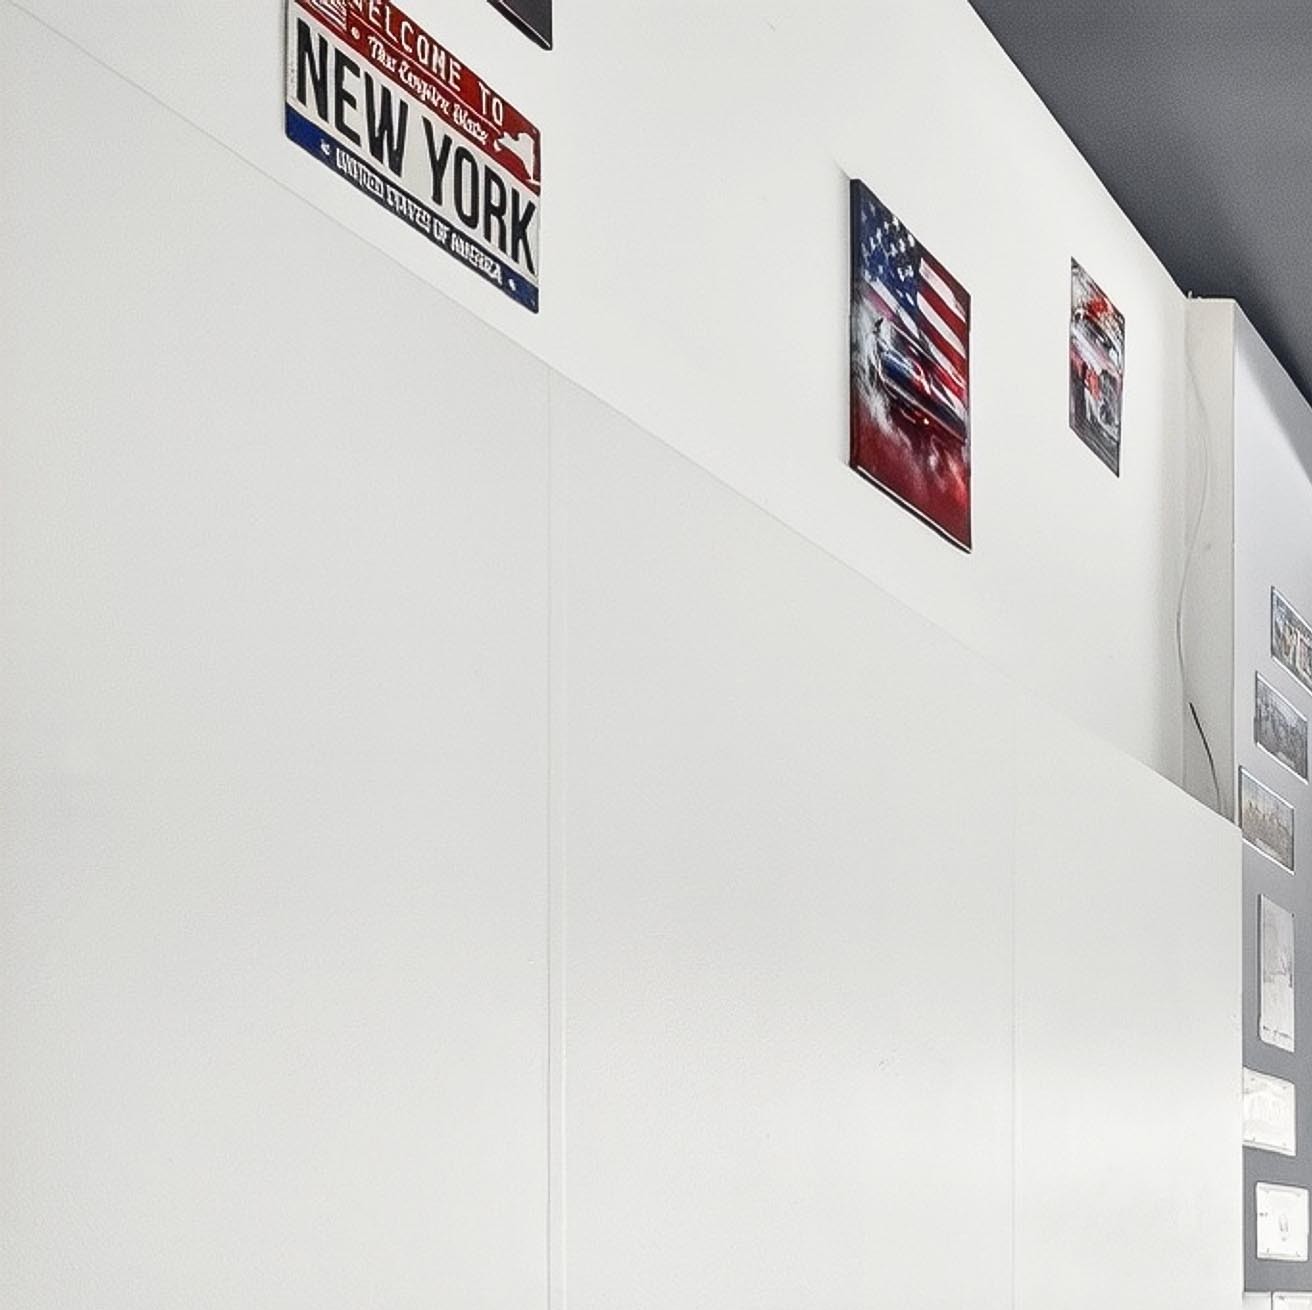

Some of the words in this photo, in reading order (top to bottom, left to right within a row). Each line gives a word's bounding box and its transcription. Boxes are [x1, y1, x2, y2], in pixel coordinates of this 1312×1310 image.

[296, 17, 409, 178] NEW
[421, 114, 538, 276] YORK
[478, 81, 503, 127] TO
